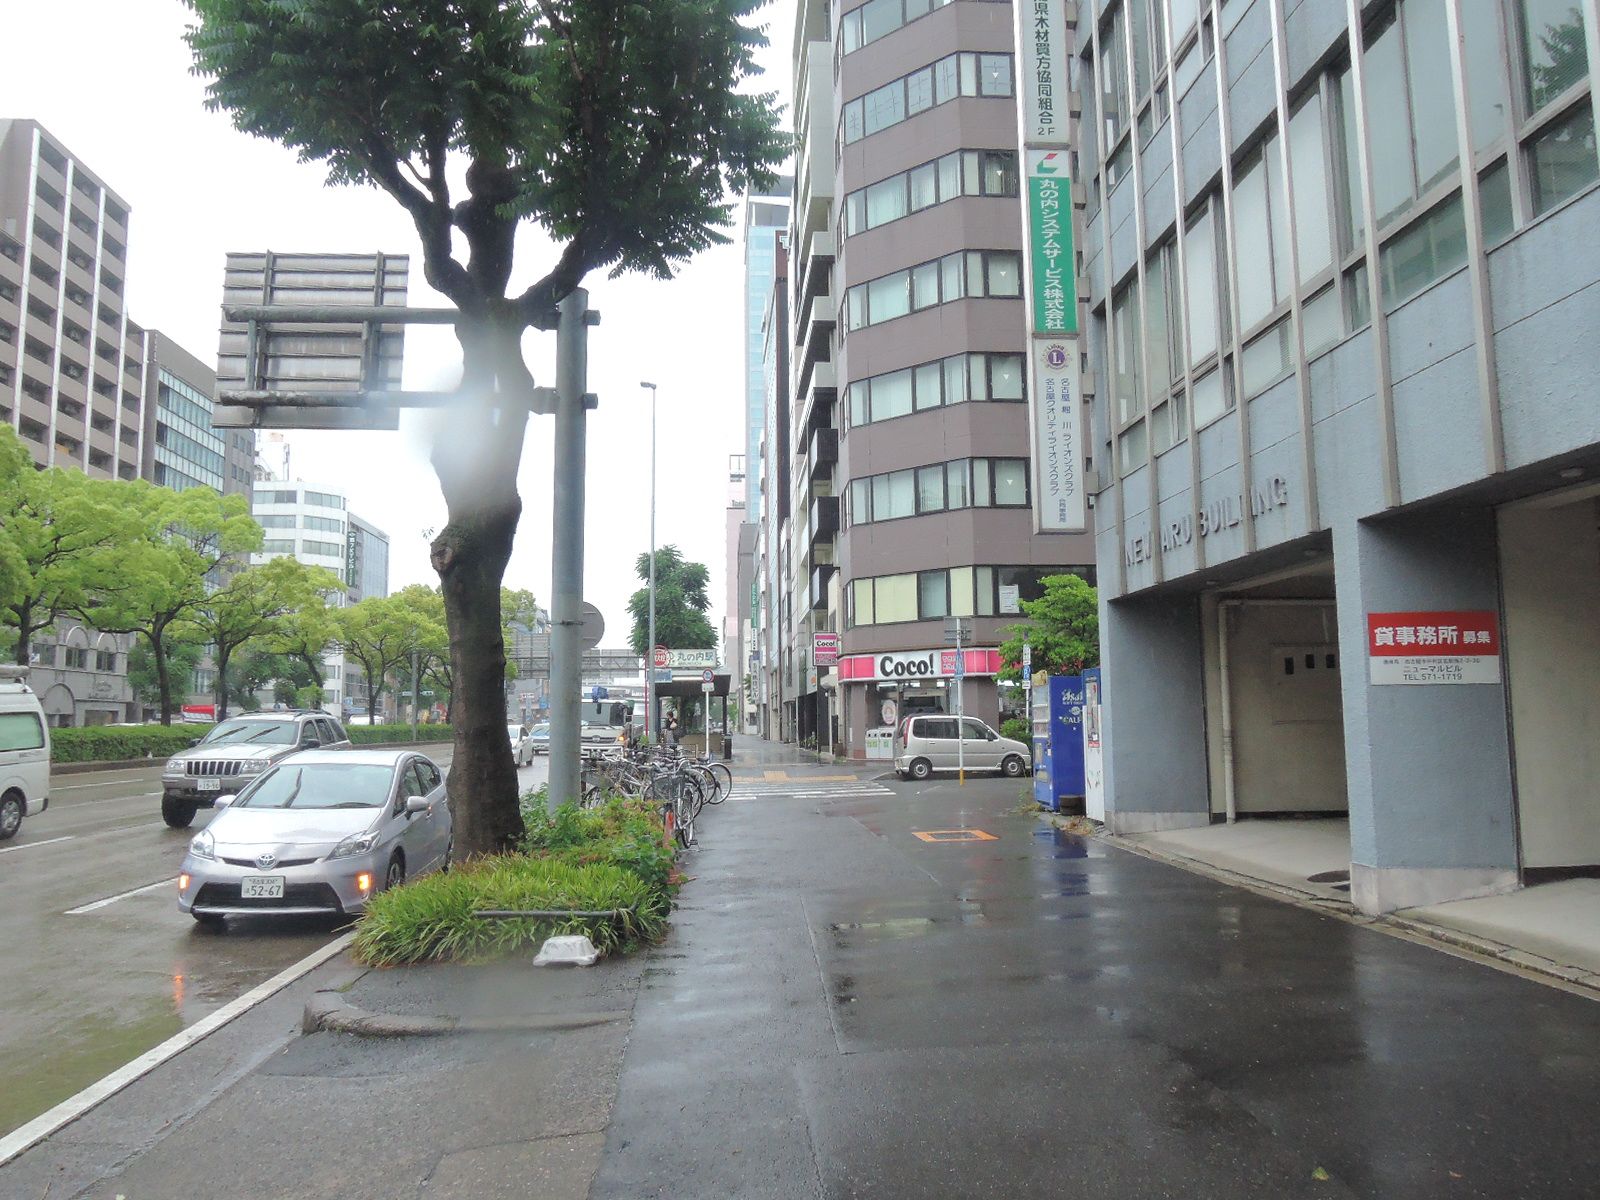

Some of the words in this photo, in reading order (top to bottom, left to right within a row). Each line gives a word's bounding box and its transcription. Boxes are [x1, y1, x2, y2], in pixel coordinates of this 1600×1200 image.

[1034, 0, 1053, 125] 県木材買方協同組合
[1040, 179, 1064, 329] 丸の内システムサービス株式会社
[1161, 514, 1192, 553] ARU
[1200, 475, 1288, 537] BUILING
[1374, 625, 1457, 646] 貸事務所
[1463, 630, 1490, 644] 募集
[677, 651, 714, 661] 丸の内駅
[880, 652, 934, 677] Coco!
[1403, 665, 1463, 673] ニューマルビル
[251, 885, 281, 896] 52-67
